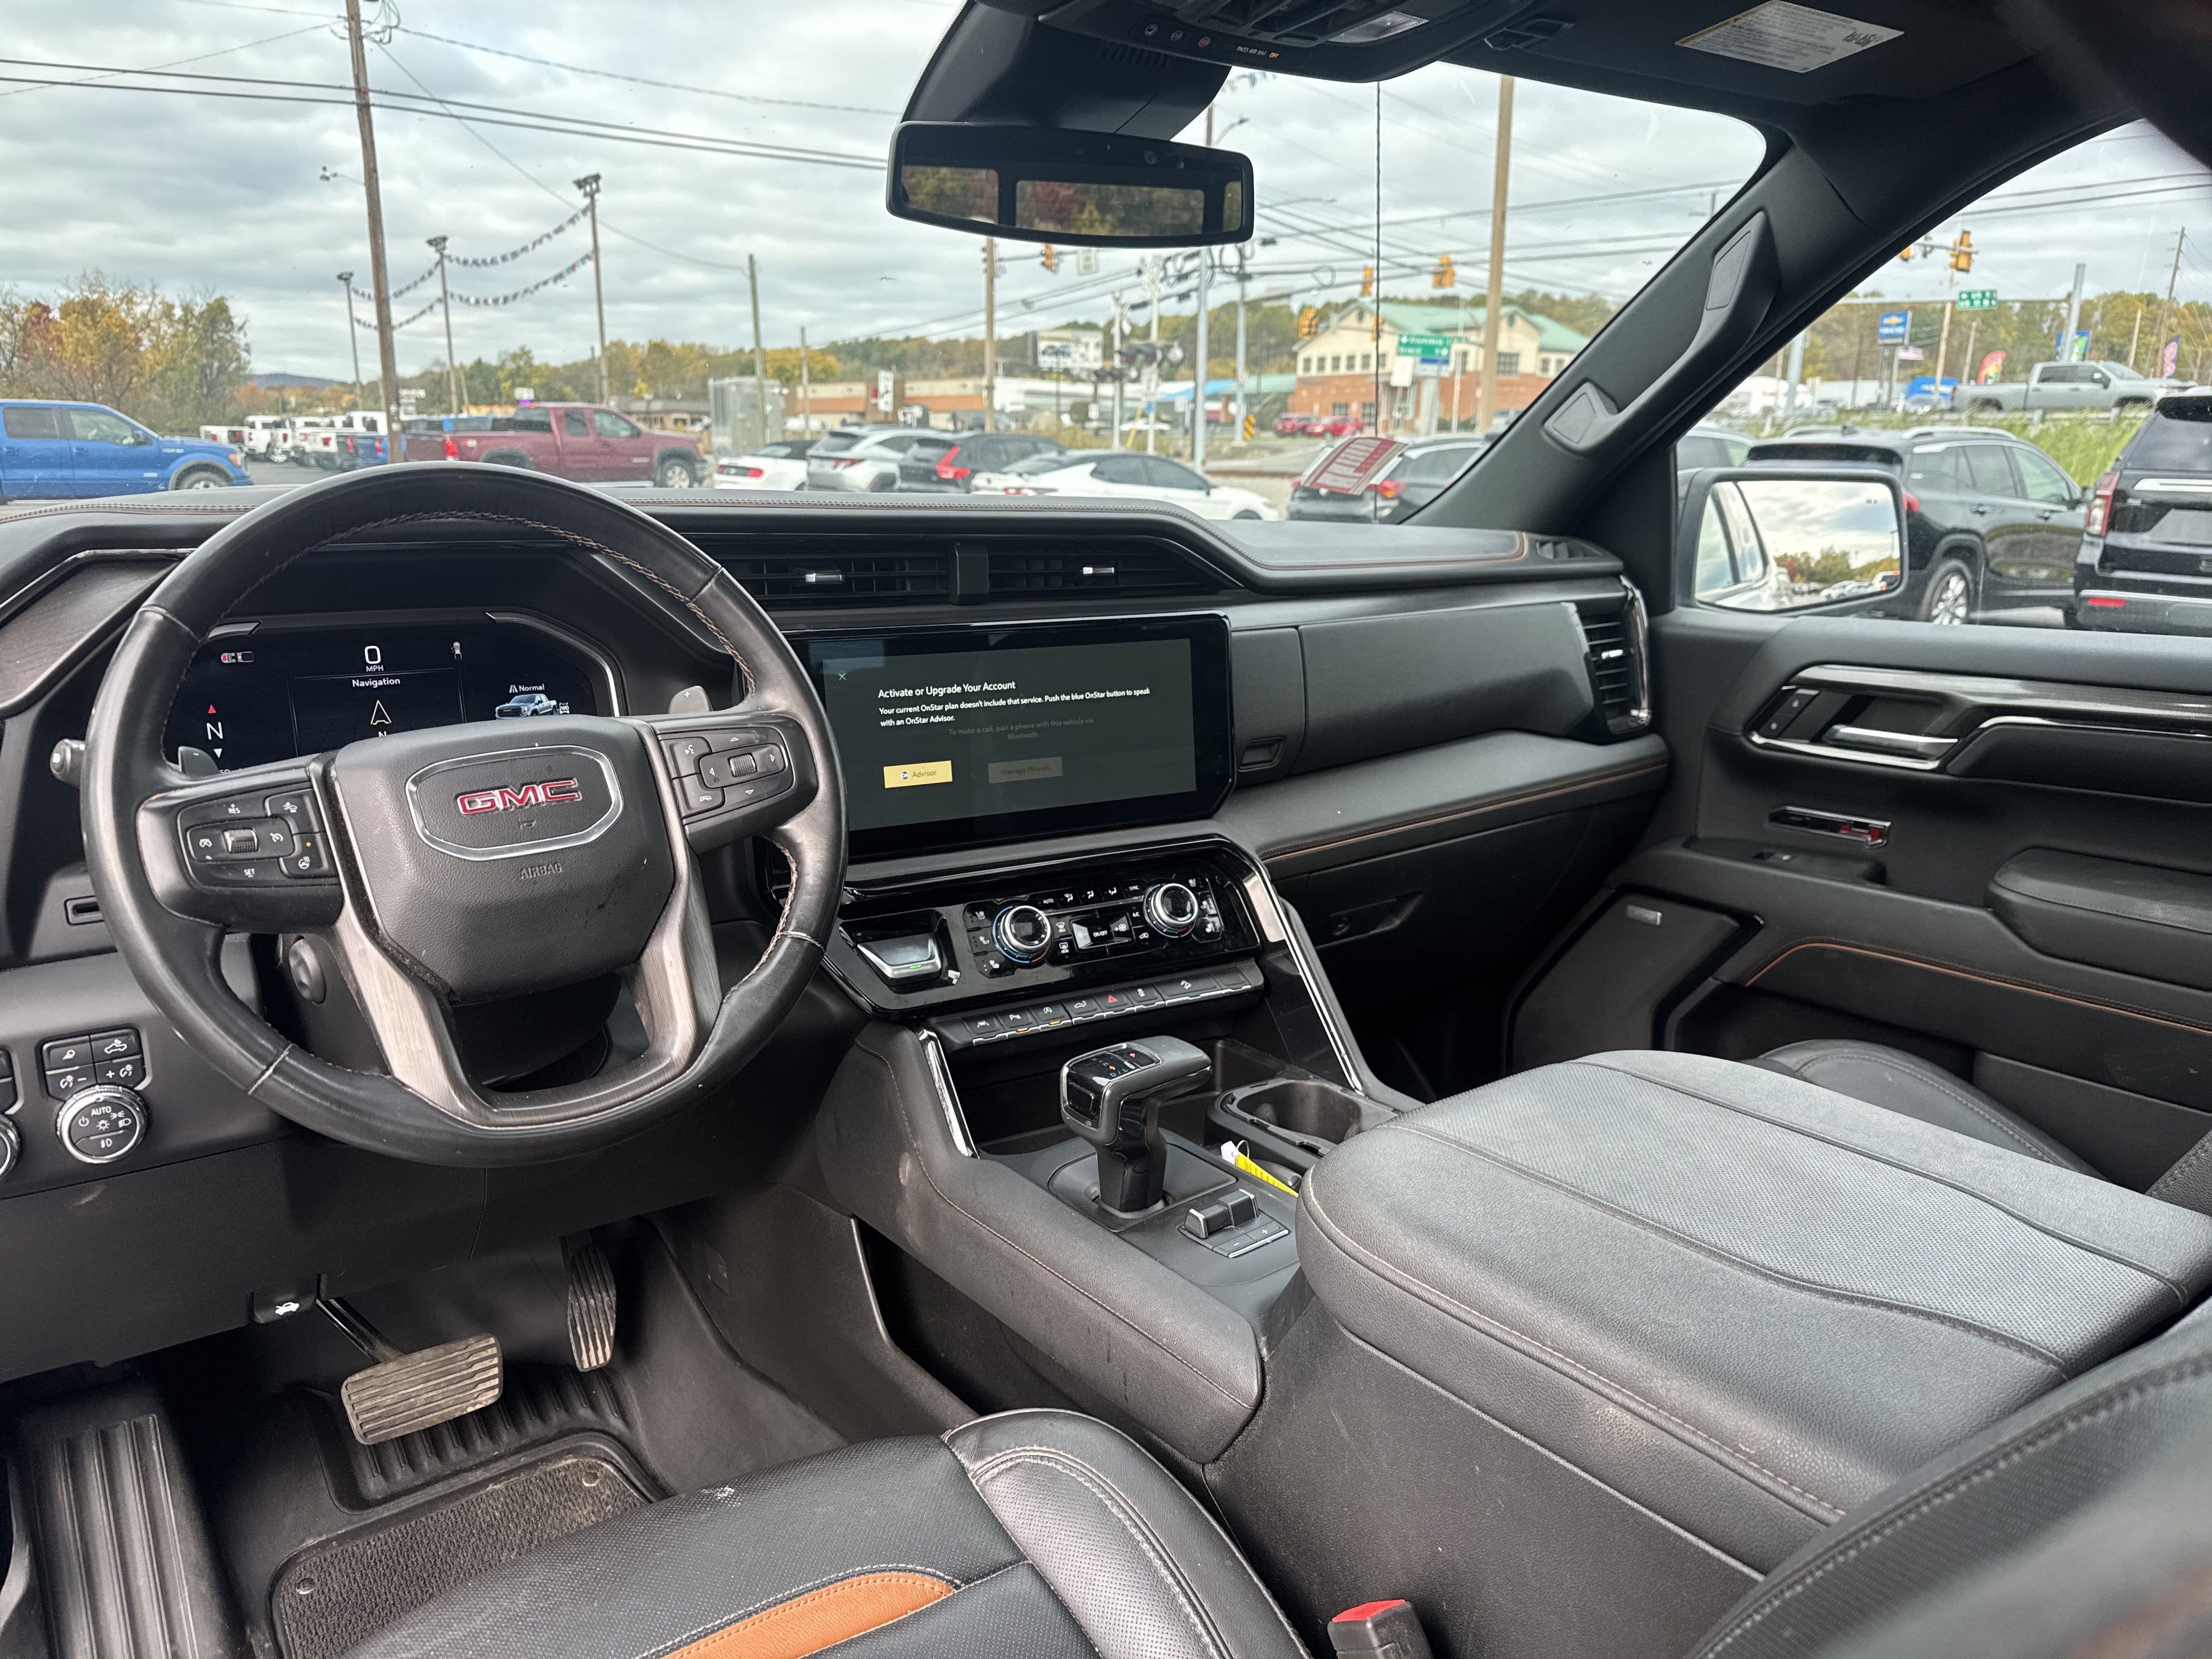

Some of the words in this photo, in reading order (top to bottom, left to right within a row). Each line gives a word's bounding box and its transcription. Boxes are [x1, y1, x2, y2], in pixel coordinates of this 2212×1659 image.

[364, 645, 381, 664] 0
[352, 677, 401, 689] Navigation
[518, 683, 545, 692] Normal
[878, 688, 913, 698] Activate
[915, 689, 924, 697] or
[926, 684, 962, 697] Upgrade
[962, 683, 982, 692] Your
[983, 681, 1016, 691] Account
[896, 705, 920, 714] current
[945, 703, 959, 712] plan
[960, 700, 984, 709] doesn't
[984, 698, 1007, 707] include
[1020, 696, 1045, 704] service.
[1085, 691, 1105, 699] OnStar
[1133, 687, 1150, 697] speak
[905, 716, 929, 724] OnStar
[929, 715, 956, 723] Advisor.
[206, 721, 224, 740] N
[981, 725, 995, 734] call,
[996, 725, 1008, 733] pair
[1015, 723, 1035, 731] phone
[1007, 732, 1040, 741] Bluetooth.
[456, 779, 583, 816] GMC
[244, 868, 255, 876] SET
[521, 862, 562, 880] AIRBAG
[91, 1105, 112, 1116] AUTO
